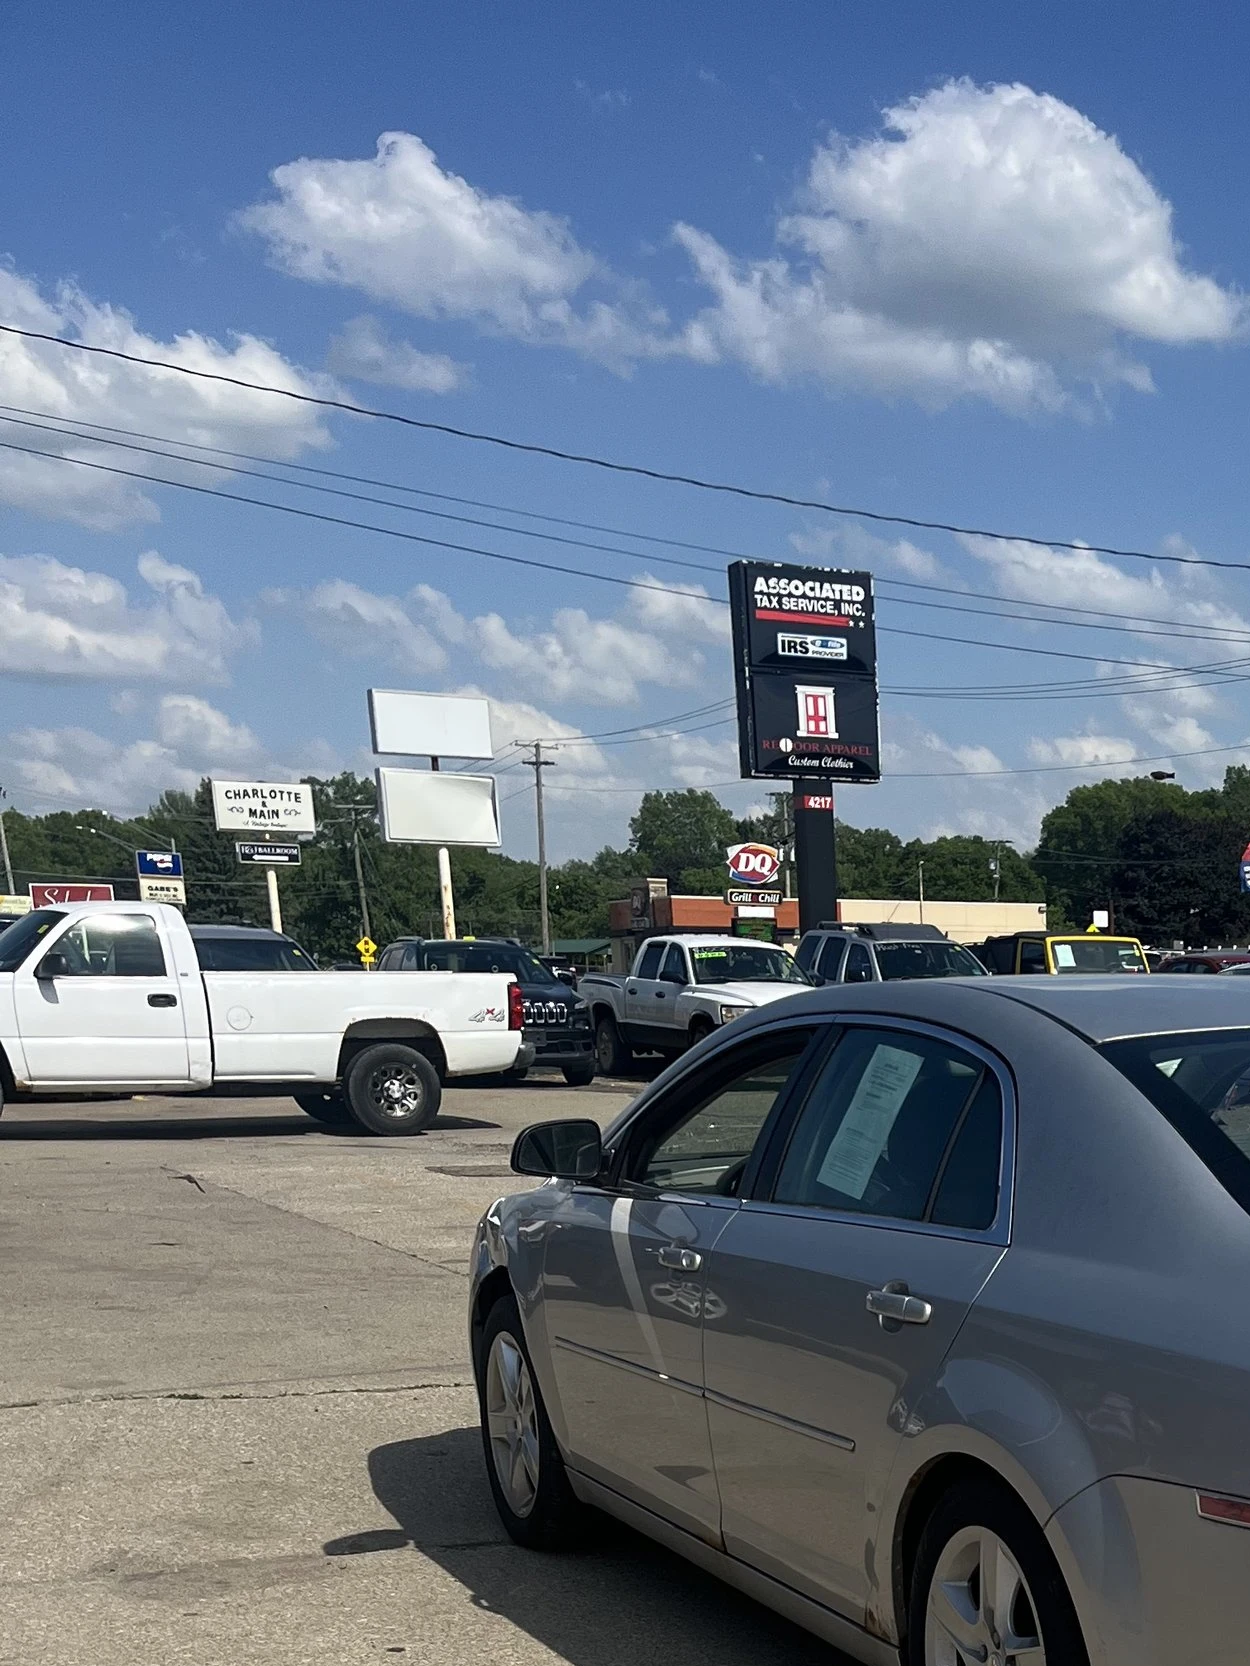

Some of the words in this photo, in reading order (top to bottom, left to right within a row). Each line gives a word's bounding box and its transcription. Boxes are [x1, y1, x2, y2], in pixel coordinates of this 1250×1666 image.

[754, 577, 865, 602] ASSOCIATED
[754, 594, 780, 609] TAX
[782, 597, 839, 617] SERVICE,
[841, 603, 866, 617] INC.
[781, 639, 809, 655] IRS
[823, 744, 872, 756] APPAREL
[788, 755, 819, 767] Custom
[821, 756, 854, 769] Clothier
[224, 788, 302, 804] CHARLOTTE
[808, 796, 832, 809] 4217
[261, 800, 268, 808] &
[248, 807, 280, 820] MAIN
[258, 847, 298, 855] BALLROOM
[737, 852, 772, 876] DQ
[147, 885, 179, 893] GABE'S
[731, 892, 752, 902] Grill
[758, 893, 780, 903] Chill
